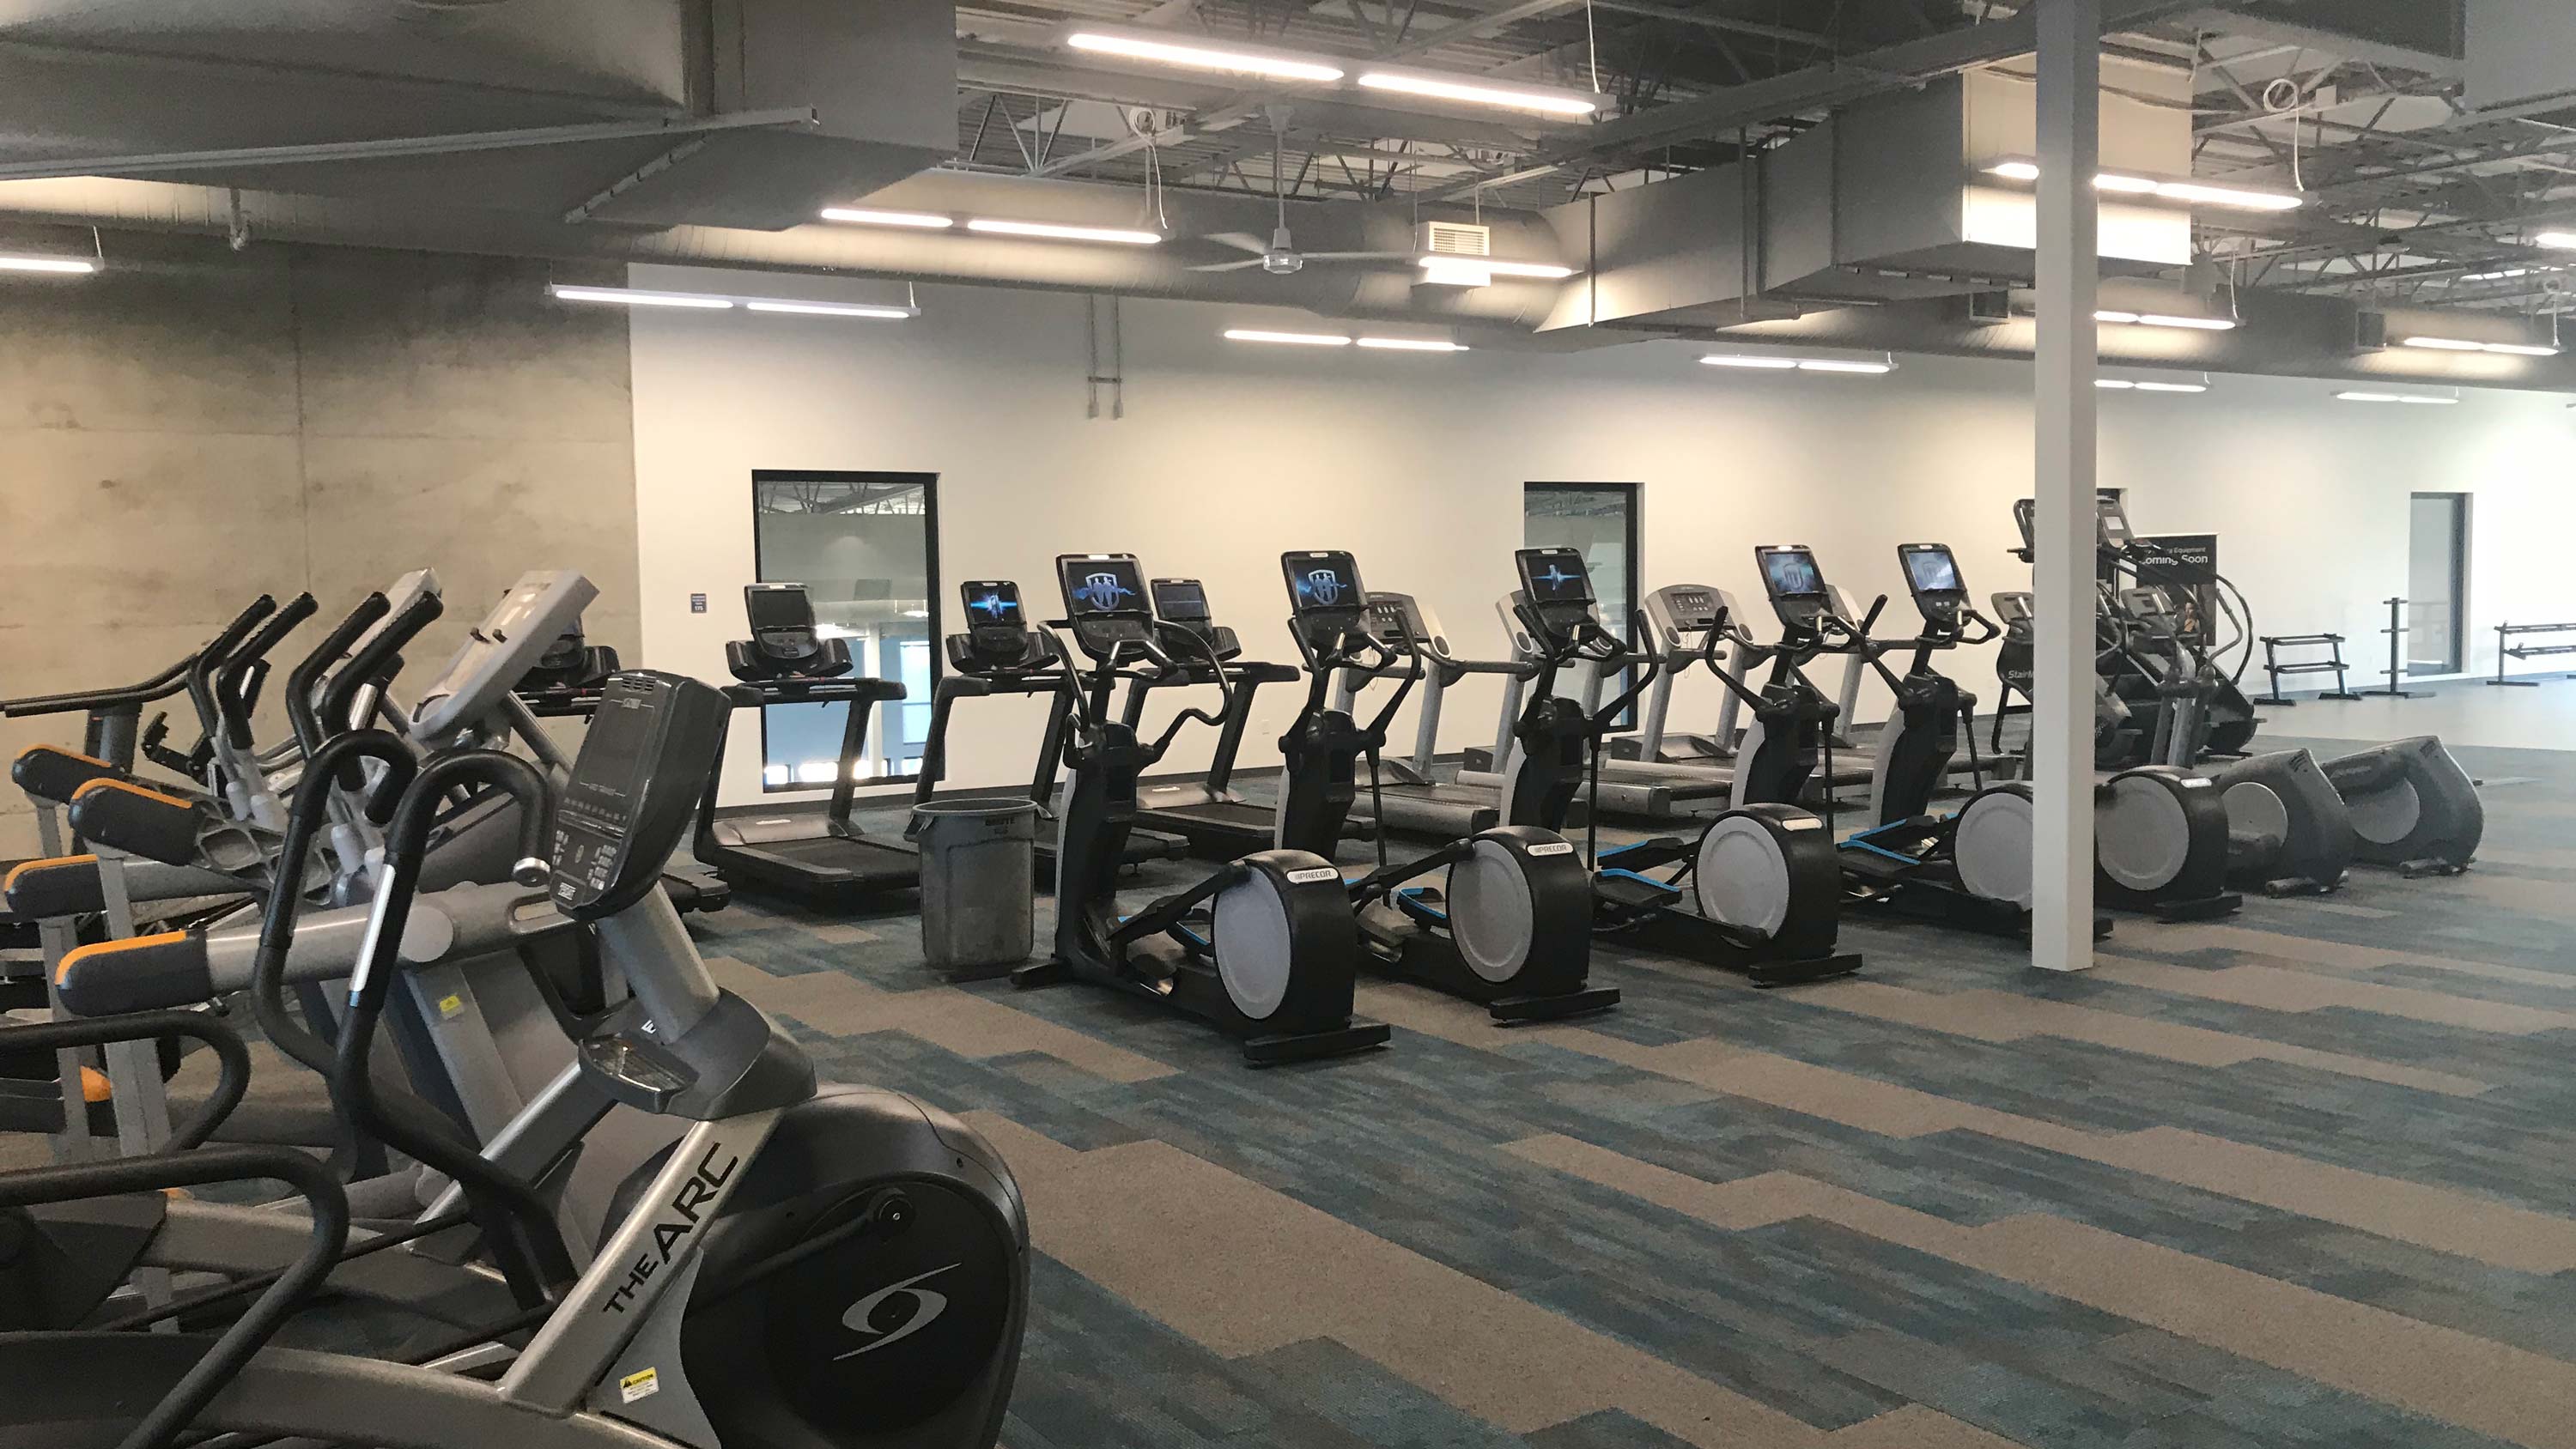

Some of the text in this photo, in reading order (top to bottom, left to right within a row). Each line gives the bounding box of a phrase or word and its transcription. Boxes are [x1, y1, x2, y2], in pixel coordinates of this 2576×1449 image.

[2140, 555, 2208, 566] oming Soon
[1298, 870, 1331, 880] PRECOR
[603, 1253, 659, 1313] THE
[653, 1143, 738, 1264] ARC
